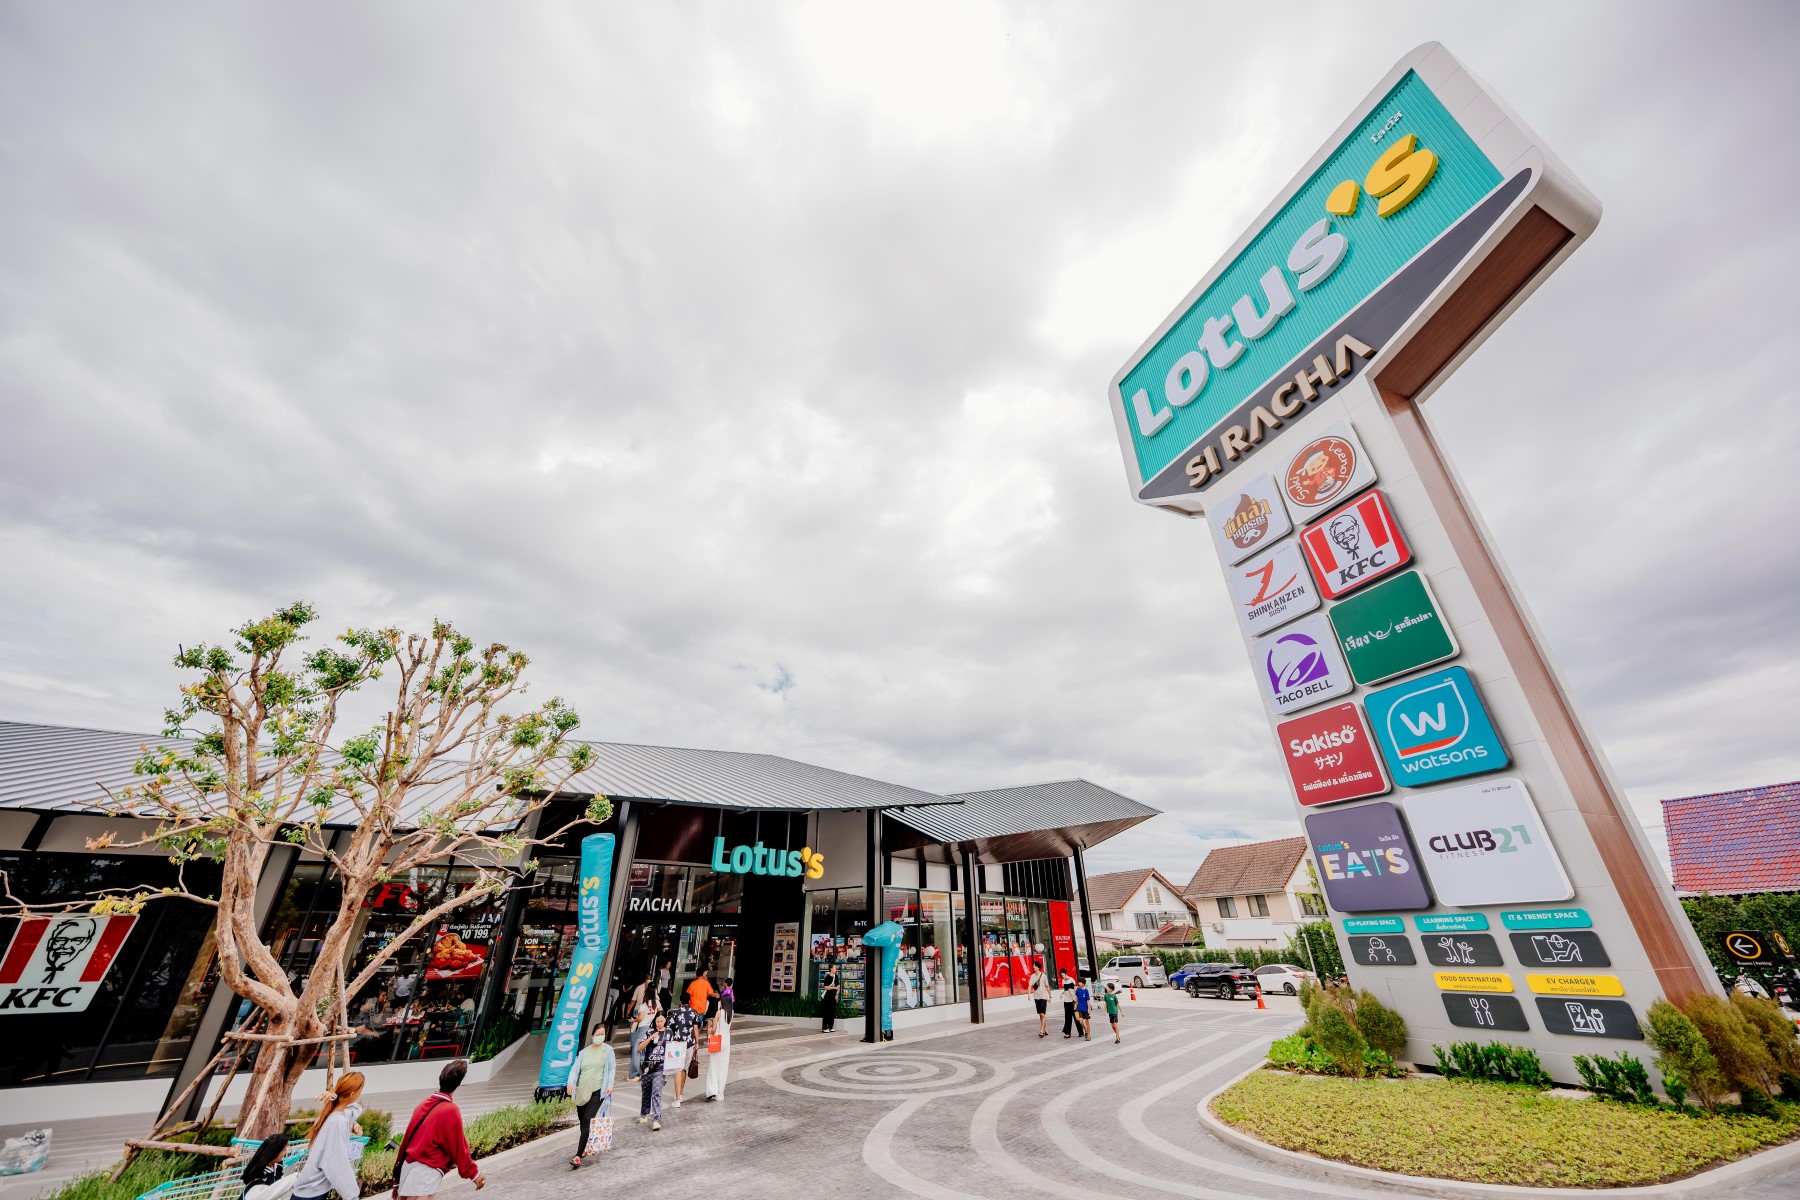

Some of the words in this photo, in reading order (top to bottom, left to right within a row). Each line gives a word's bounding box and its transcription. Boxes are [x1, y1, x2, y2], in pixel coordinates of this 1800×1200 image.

[1371, 111, 1403, 144] โลตัส
[1132, 133, 1439, 437] Lotus's
[1185, 446, 1221, 488] SI
[1220, 334, 1376, 461] RACHA
[1328, 439, 1349, 478] Teenoi
[1339, 550, 1386, 585] KFC
[1248, 585, 1305, 620] SHINKANZEN
[1268, 604, 1287, 617] SUSHI
[1276, 690, 1303, 705] TACO
[1304, 680, 1333, 695] BELL
[1290, 725, 1357, 757] Sakiso
[1314, 751, 1343, 770] サキソ
[1402, 745, 1488, 773] watsons
[711, 836, 824, 879] Lotus's
[1317, 840, 1350, 852] Lotus's
[1440, 850, 1485, 860] FITNESS
[1321, 847, 1410, 880] EATS
[629, 897, 683, 912] RACHA
[1554, 911, 1579, 919] SPACE
[1422, 916, 1454, 924] LEARNING
[1454, 915, 1475, 923] SPACE
[461, 930, 471, 939] 10
[0, 986, 82, 1009] KFC
[1570, 1005, 1581, 1014] EV
[551, 962, 593, 1068] Lotus's
